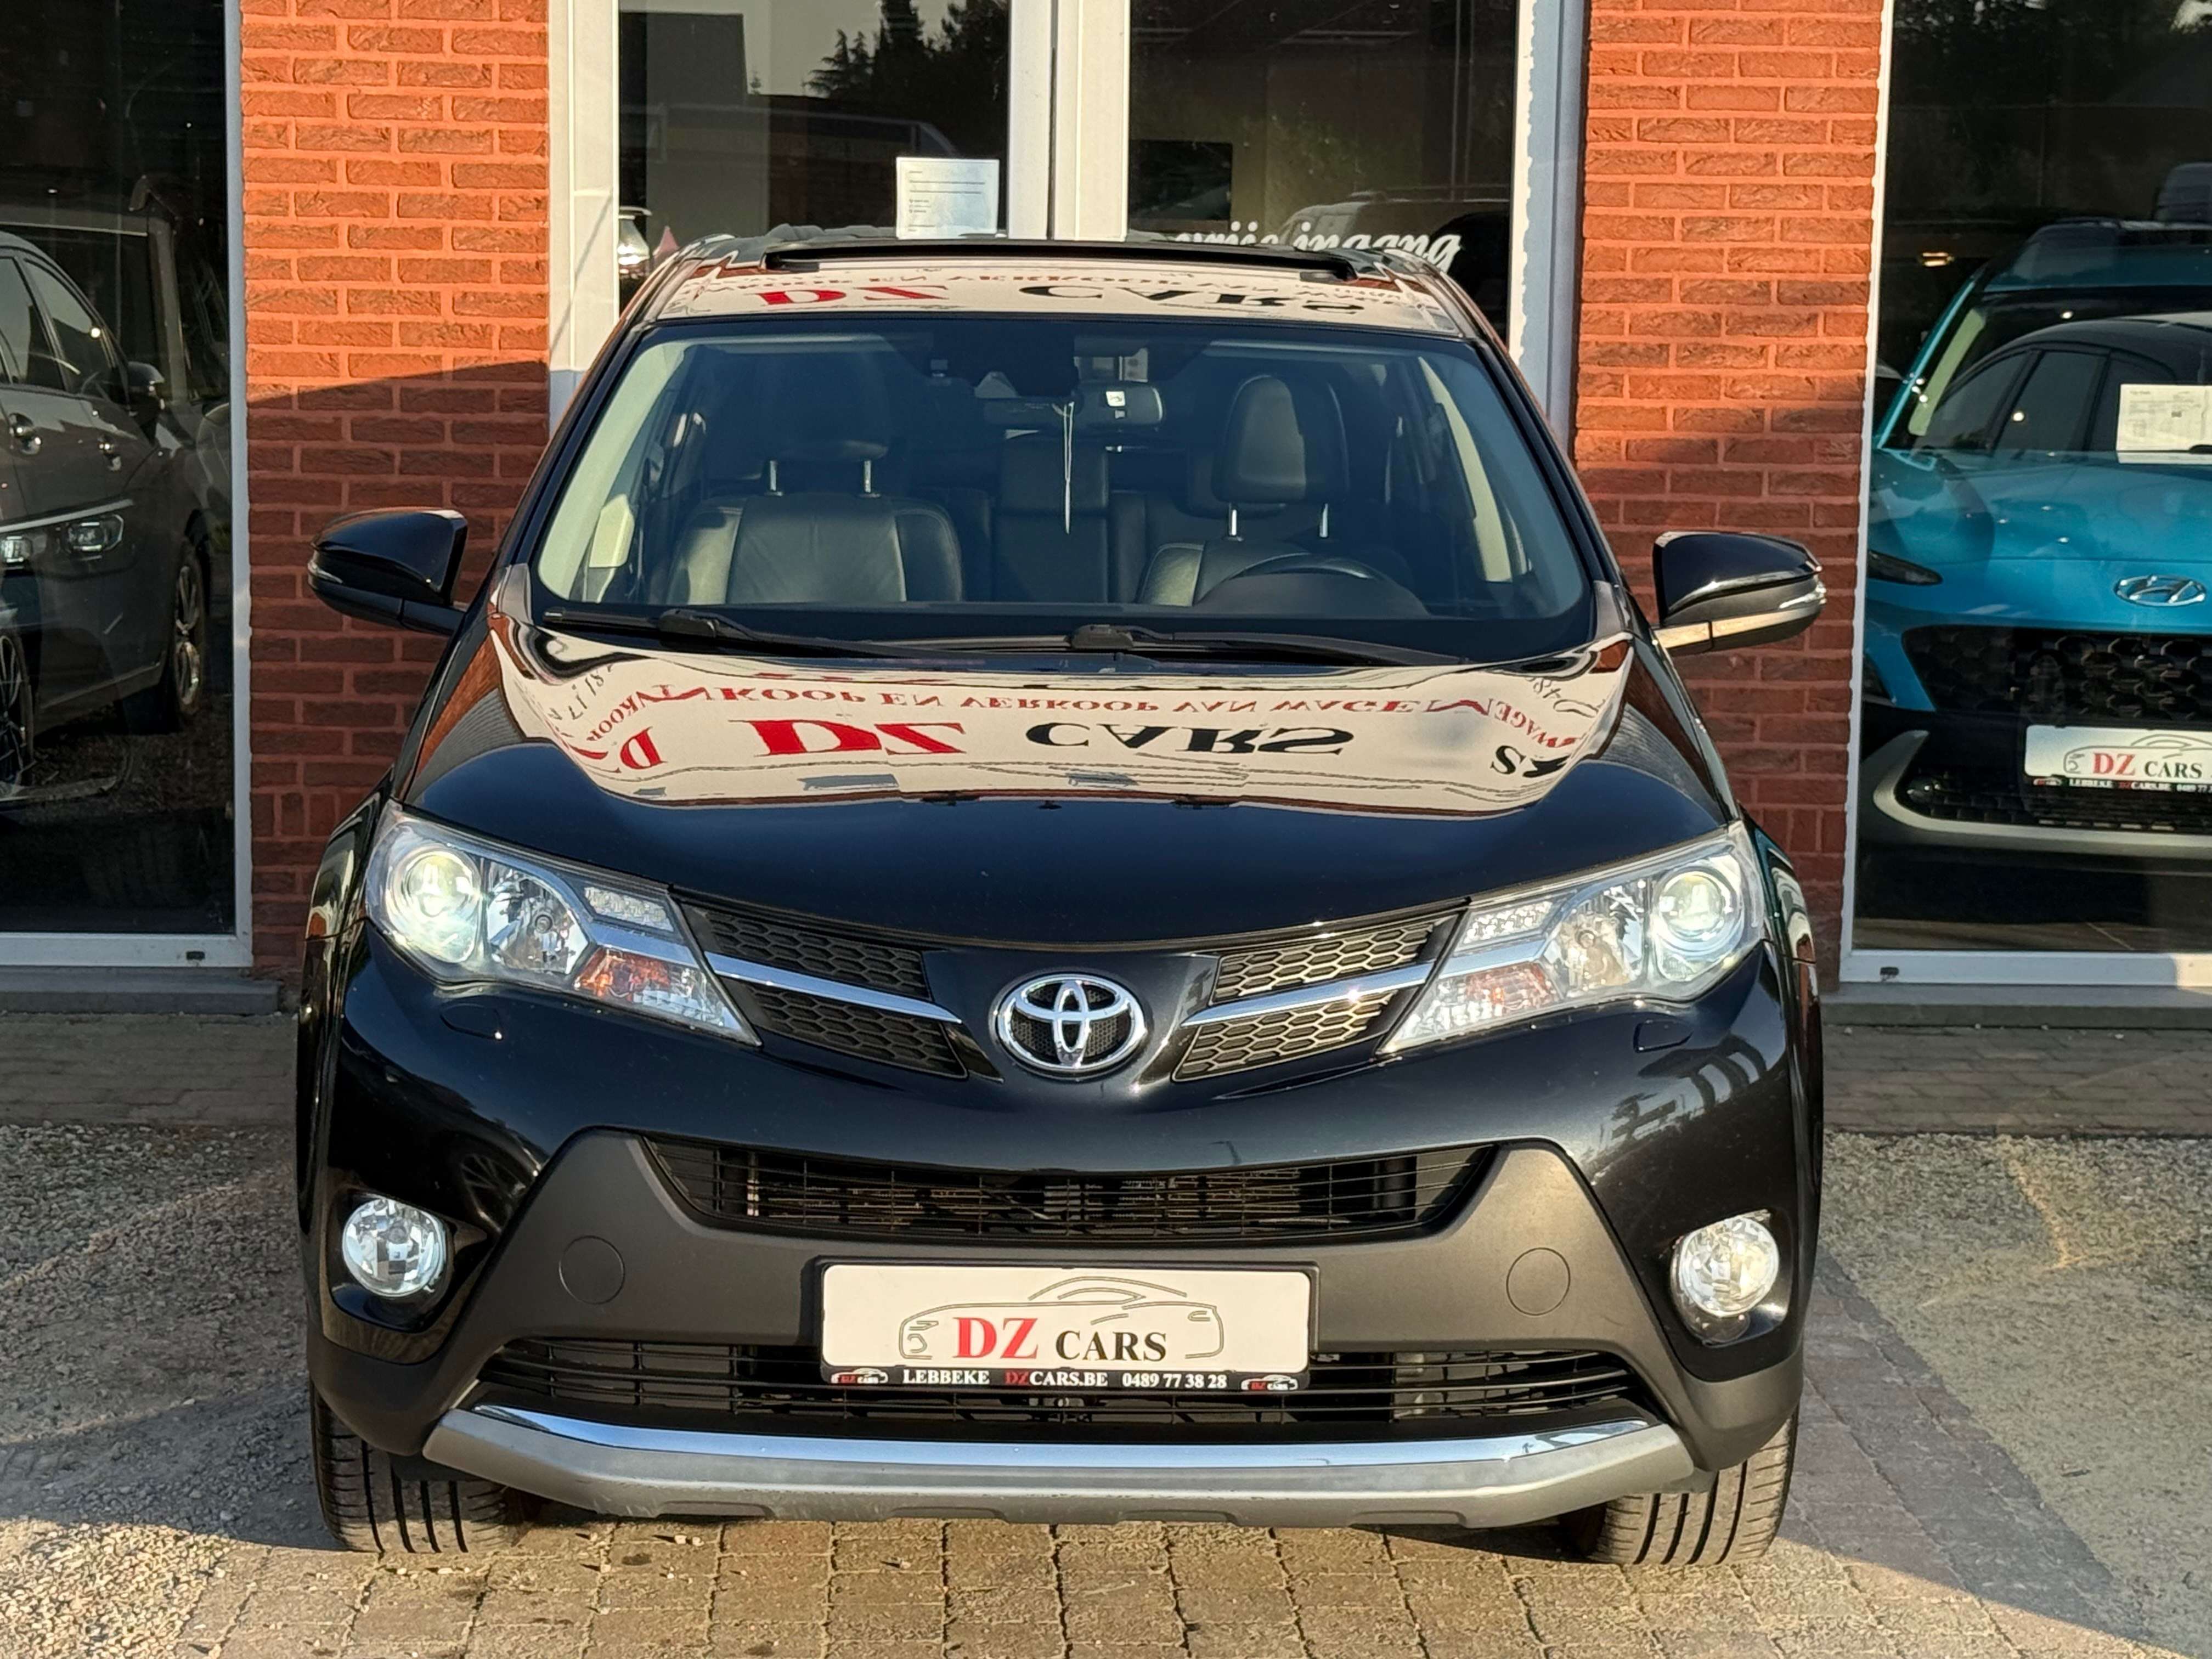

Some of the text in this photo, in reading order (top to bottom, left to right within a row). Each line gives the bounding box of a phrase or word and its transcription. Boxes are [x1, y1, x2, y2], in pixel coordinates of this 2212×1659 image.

[2092, 752, 2202, 778] DZ CARS
[953, 1317, 1167, 1362] DZ CARS
[902, 1369, 1227, 1389] LEBBEKE DZCARS.BE 0489 77 38 28
